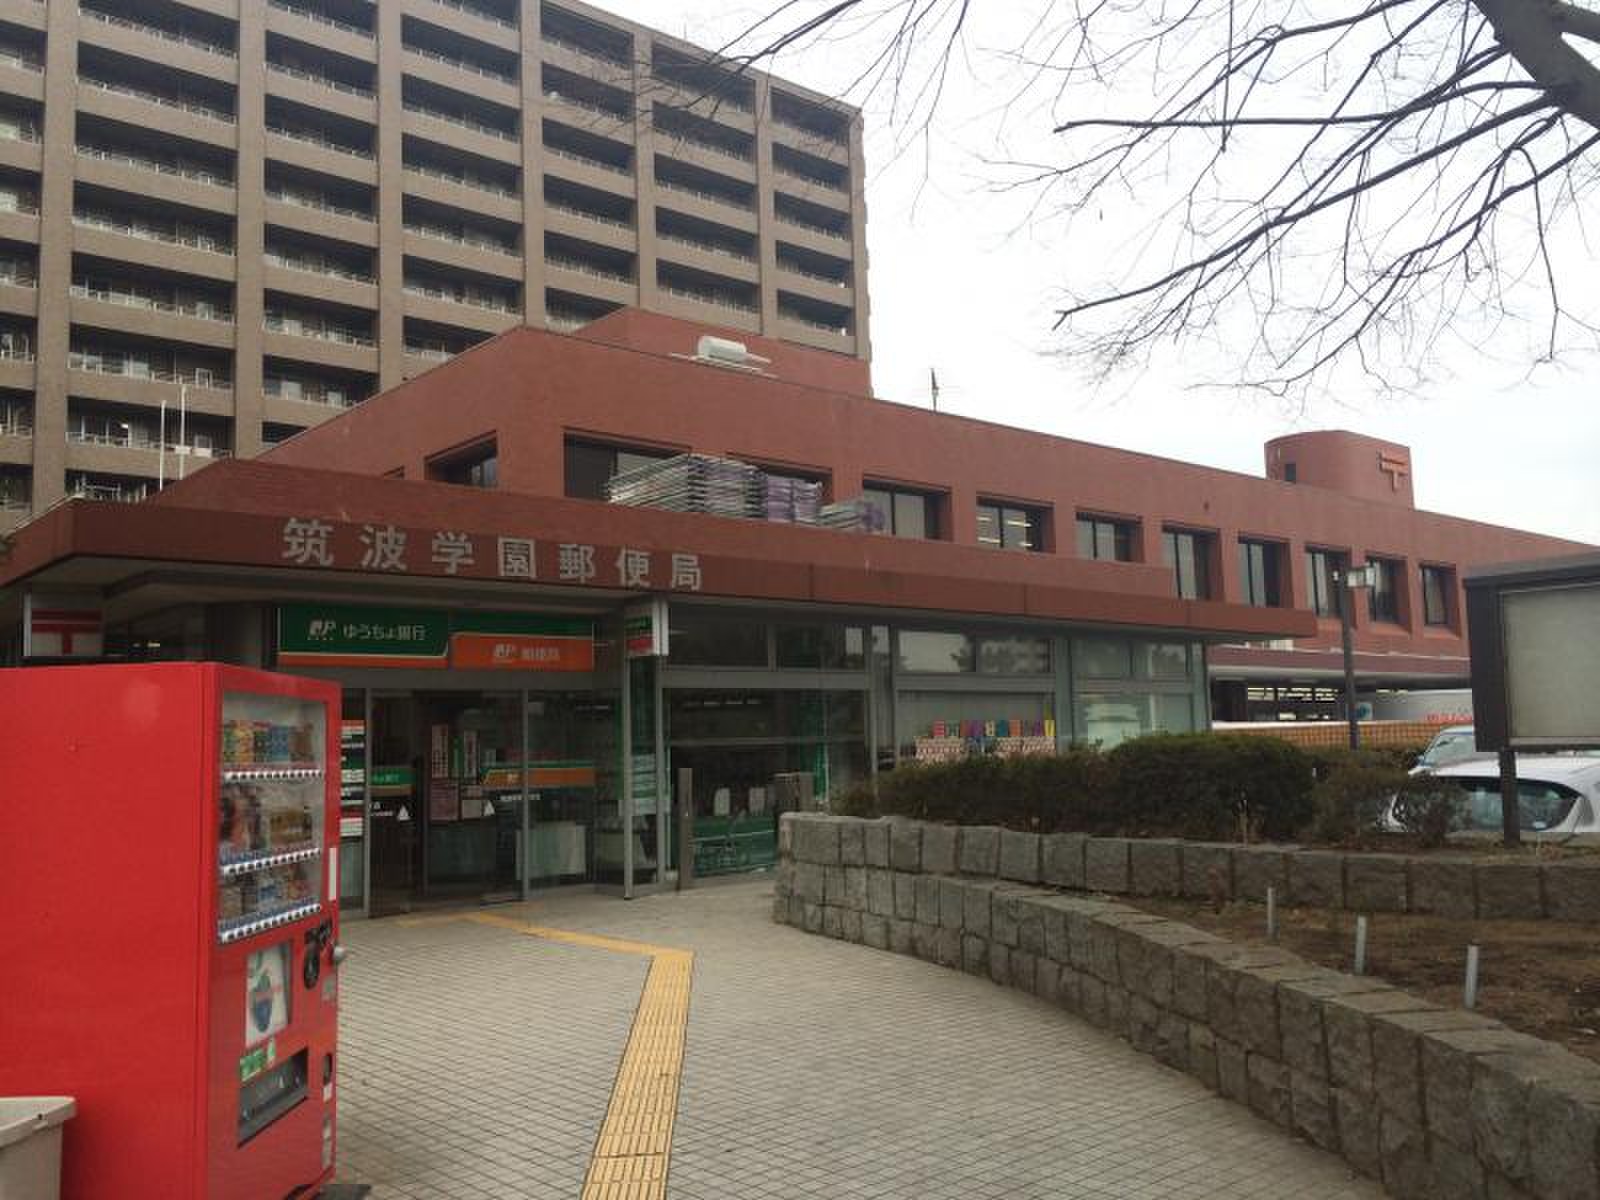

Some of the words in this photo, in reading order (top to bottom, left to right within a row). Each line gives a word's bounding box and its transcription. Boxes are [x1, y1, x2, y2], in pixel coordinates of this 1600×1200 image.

[282, 517, 702, 591] 筑波学園郵便局
